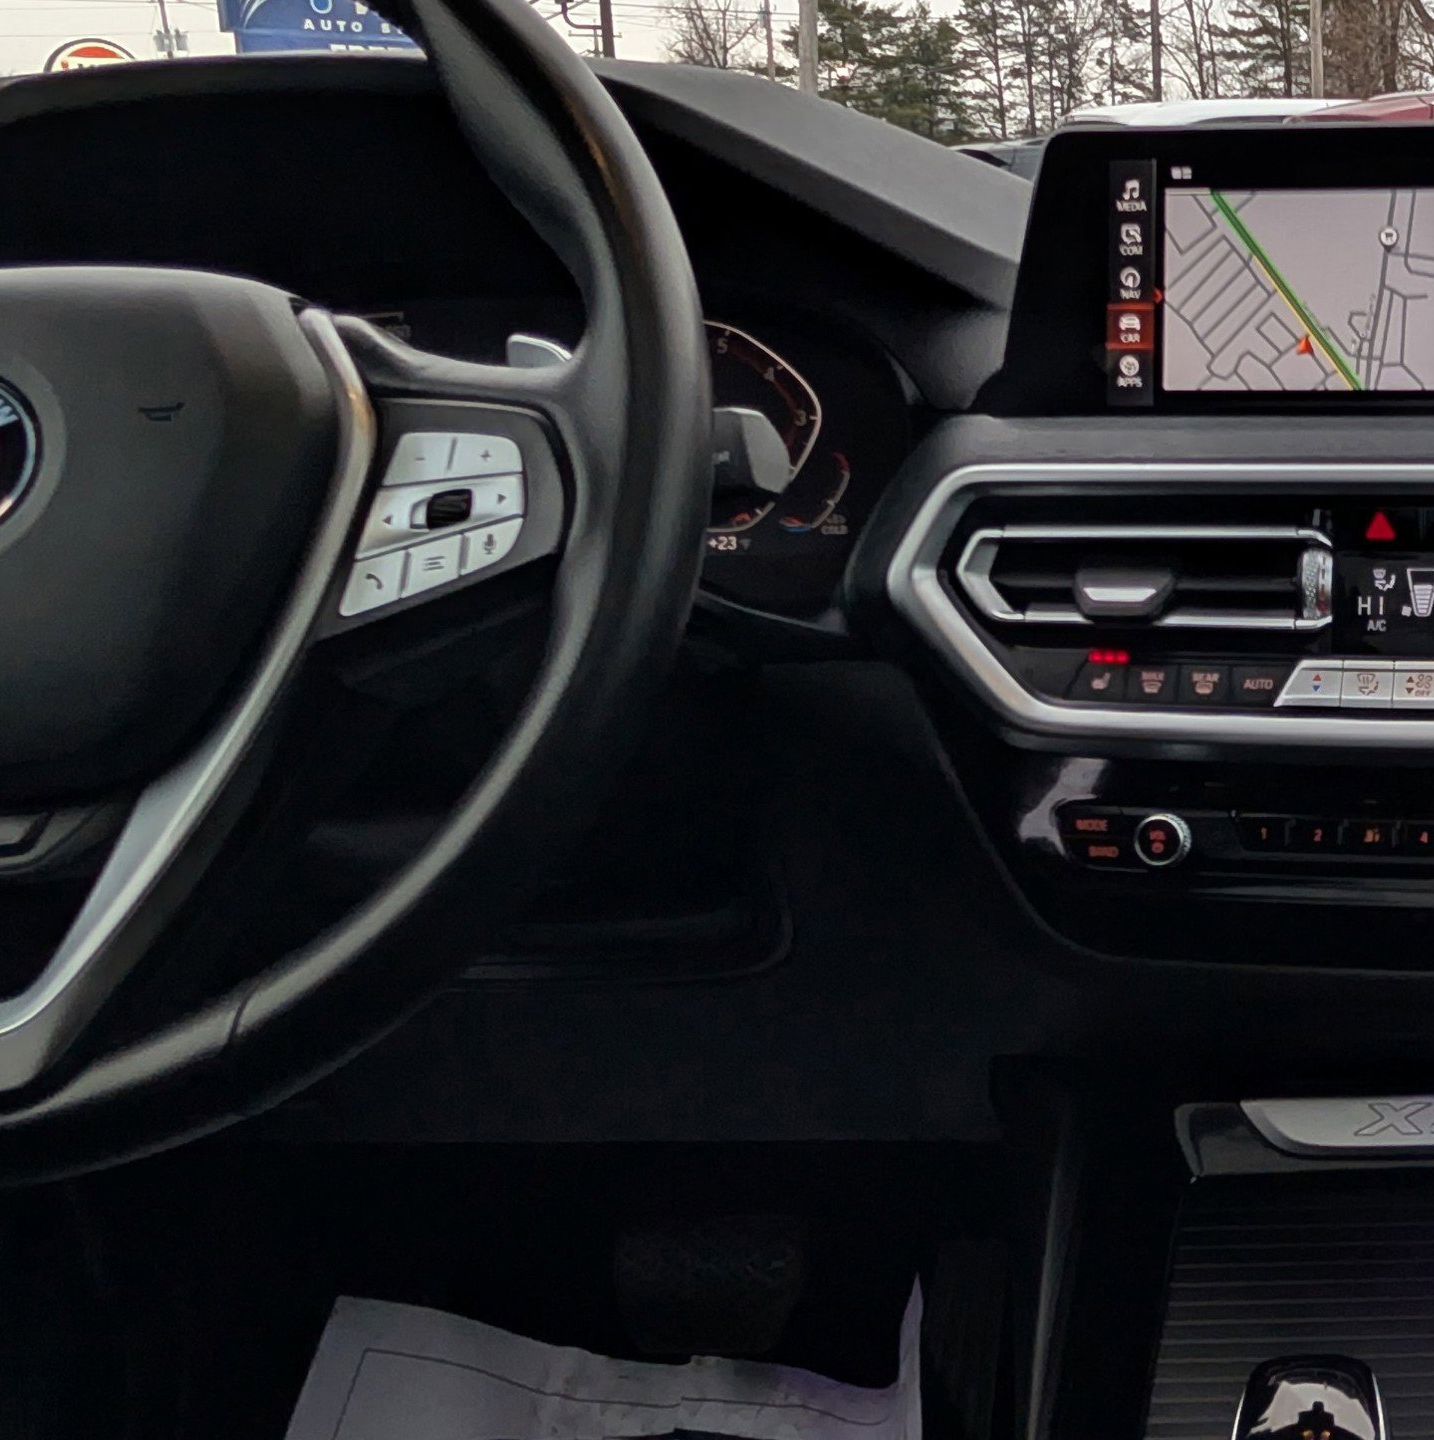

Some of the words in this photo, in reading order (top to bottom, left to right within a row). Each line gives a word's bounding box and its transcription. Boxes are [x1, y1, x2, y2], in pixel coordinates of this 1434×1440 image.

[304, 18, 363, 32] AUTO
[1357, 595, 1384, 616] HI
[1367, 619, 1387, 633] A/C
[1242, 677, 1274, 691] AUTO
